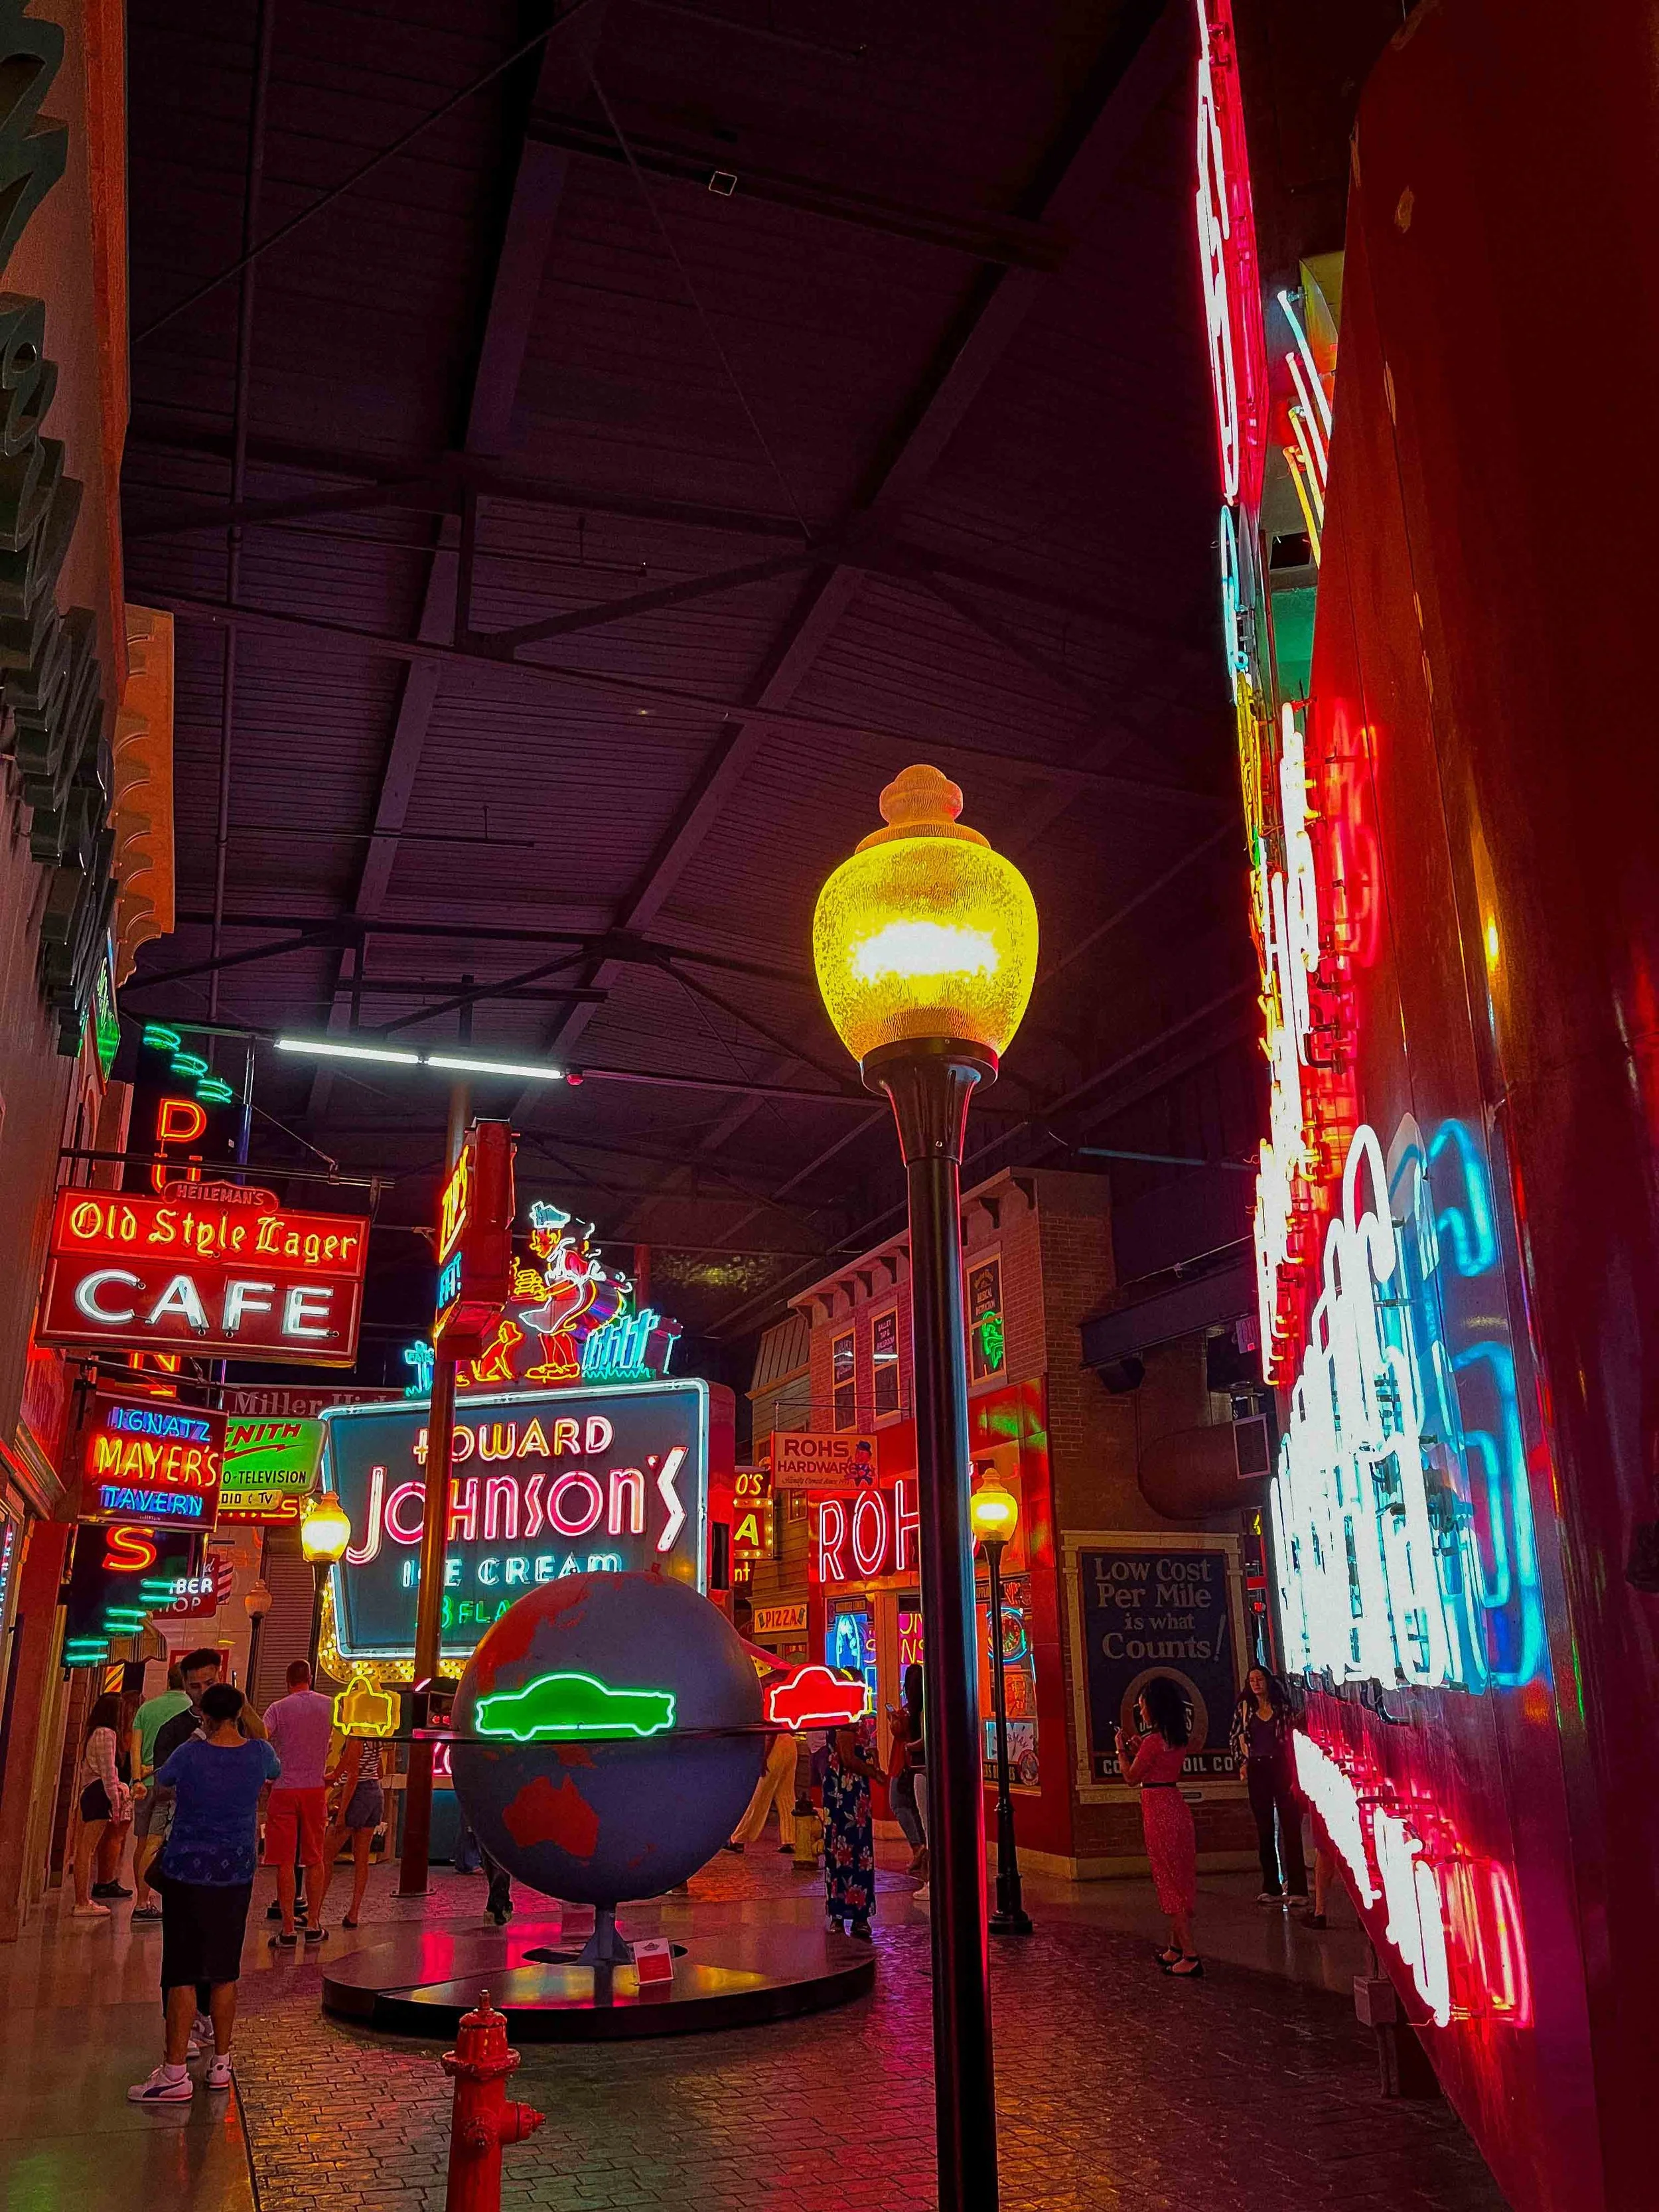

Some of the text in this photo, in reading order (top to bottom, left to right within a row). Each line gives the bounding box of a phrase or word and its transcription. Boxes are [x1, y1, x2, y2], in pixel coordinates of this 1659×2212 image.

[176, 1185, 264, 1205] HEILEMAN'S
[70, 1202, 357, 1264] Old Style Lager
[74, 1269, 334, 1338] CAFE
[232, 1391, 323, 1416] Miller
[109, 1407, 211, 1441] IGNATZ
[226, 1424, 302, 1449] NITH
[784, 1439, 849, 1457] ROHS
[96, 1436, 220, 1487] MAYER'S
[778, 1460, 857, 1474] HARDWARE
[223, 1470, 306, 1485] O-TELEVISION
[102, 1485, 203, 1516] TAVERN
[820, 1479, 920, 1582] ROH
[402, 1558, 463, 1587] IE
[1094, 1558, 1212, 1582] Low Cost
[1097, 1583, 1212, 1608] Per Mile
[765, 1609, 797, 1627] PIZZA
[1124, 1613, 1195, 1631] is what
[1183, 1756, 1234, 1772] OIL CO
